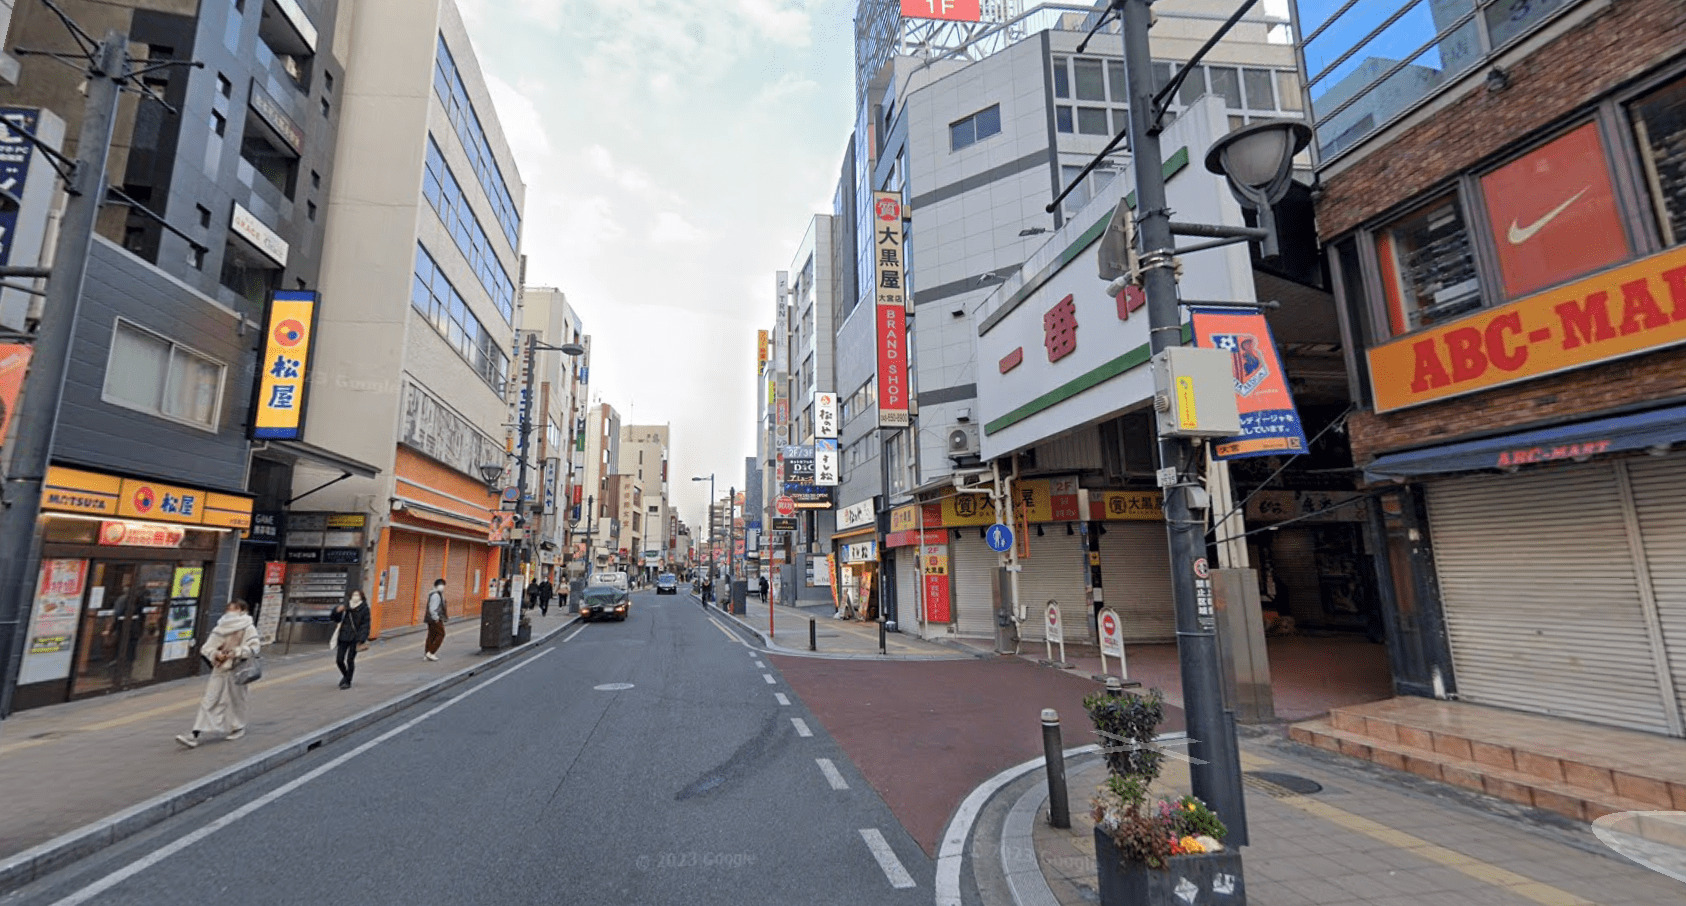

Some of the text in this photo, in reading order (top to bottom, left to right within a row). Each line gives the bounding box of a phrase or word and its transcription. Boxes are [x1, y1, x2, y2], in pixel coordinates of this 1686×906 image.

[878, 226, 901, 289] 大黒屋
[878, 294, 903, 303] 大宮店
[886, 309, 898, 360] BRAND
[267, 354, 300, 409] 松屋
[888, 364, 899, 406] SHOP
[819, 408, 833, 436] 松のや
[1497, 440, 1611, 467] ABC-MART
[820, 454, 833, 481] すし松
[160, 492, 195, 516] 松屋
[979, 486, 1036, 510] 大屋
